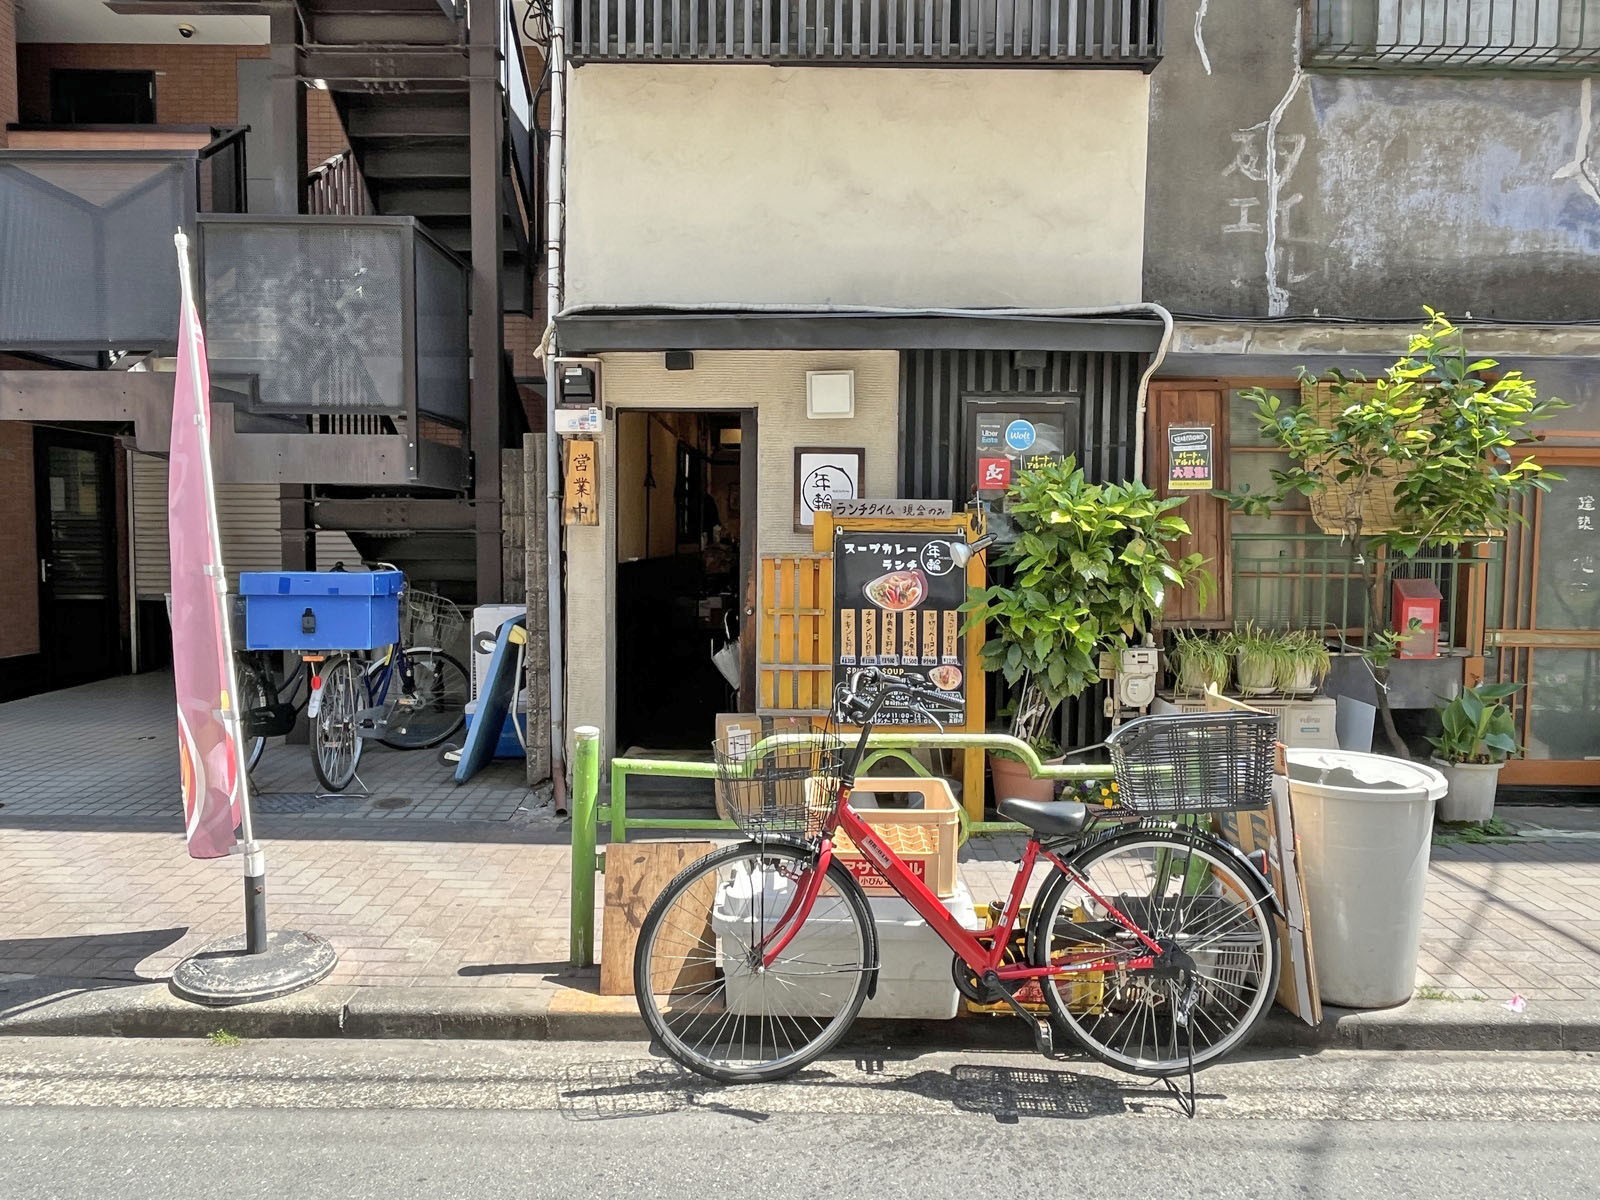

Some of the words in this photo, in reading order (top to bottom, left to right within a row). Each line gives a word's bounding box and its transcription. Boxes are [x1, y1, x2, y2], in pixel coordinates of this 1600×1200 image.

[1010, 431, 1031, 440] Wolt
[572, 453, 592, 523] 営業中
[836, 502, 895, 516] ランチタイム
[903, 503, 945, 517] 現金のみ
[844, 542, 917, 555] スープカレー
[882, 559, 918, 571] ランチ
[881, 667, 905, 676] SOUP
